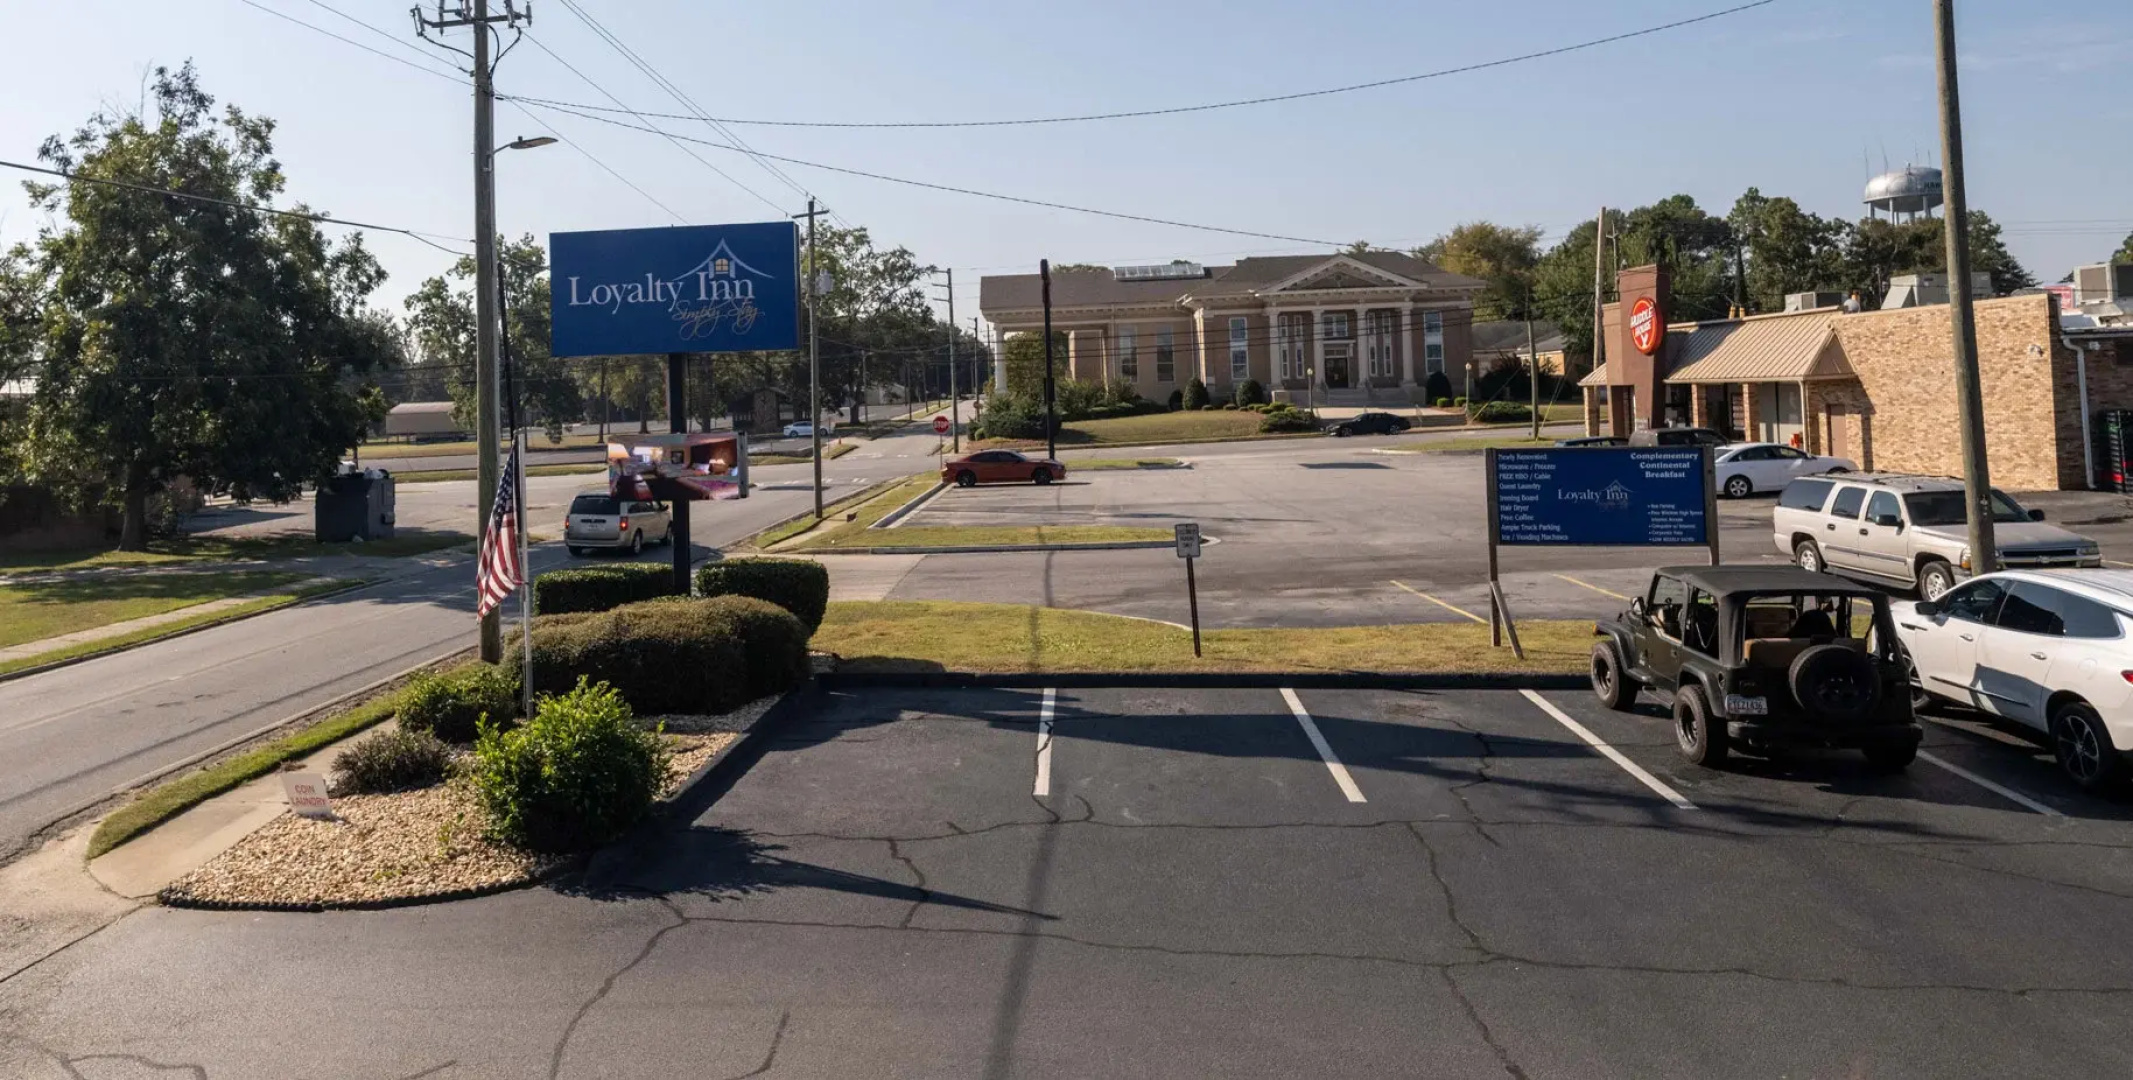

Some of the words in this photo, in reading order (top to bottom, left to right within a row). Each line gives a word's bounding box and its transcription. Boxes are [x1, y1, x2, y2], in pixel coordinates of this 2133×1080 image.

[568, 272, 685, 315] Loyalty
[697, 271, 755, 301] Inn
[934, 420, 949, 429] STOP
[1630, 452, 1699, 461] Complementary
[1640, 461, 1690, 469] Continental
[1645, 470, 1685, 478] Breakfast
[1517, 483, 1541, 491] Laundry
[1558, 489, 1602, 503] Loyalty
[1606, 489, 1628, 500] Inn
[1513, 504, 1529, 512] Dryer
[1514, 513, 1534, 521] Coffee
[1539, 524, 1561, 532] Parking
[294, 784, 315, 793] COIN
[291, 797, 326, 806] LAUNDRY
